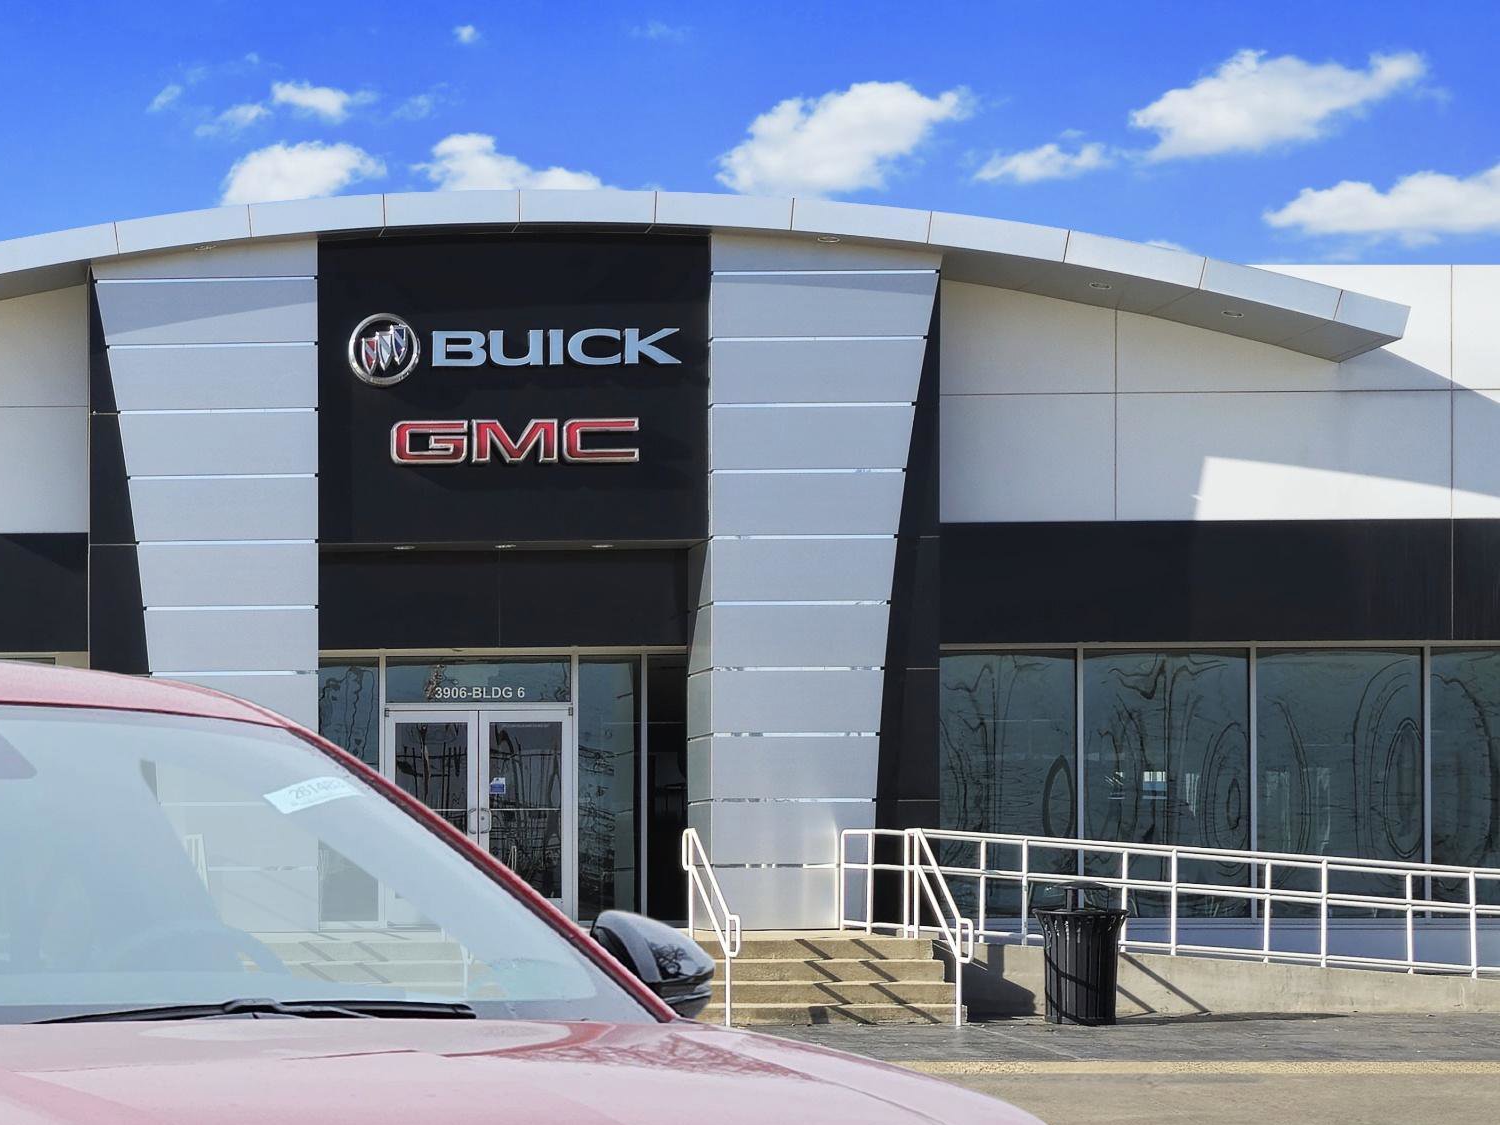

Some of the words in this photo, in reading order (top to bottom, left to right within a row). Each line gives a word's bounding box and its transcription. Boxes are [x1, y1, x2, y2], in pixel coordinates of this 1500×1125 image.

[432, 327, 682, 367] BUICK
[390, 416, 640, 464] GMC
[434, 686, 513, 699] 3906-BLDG
[516, 686, 526, 699] 6
